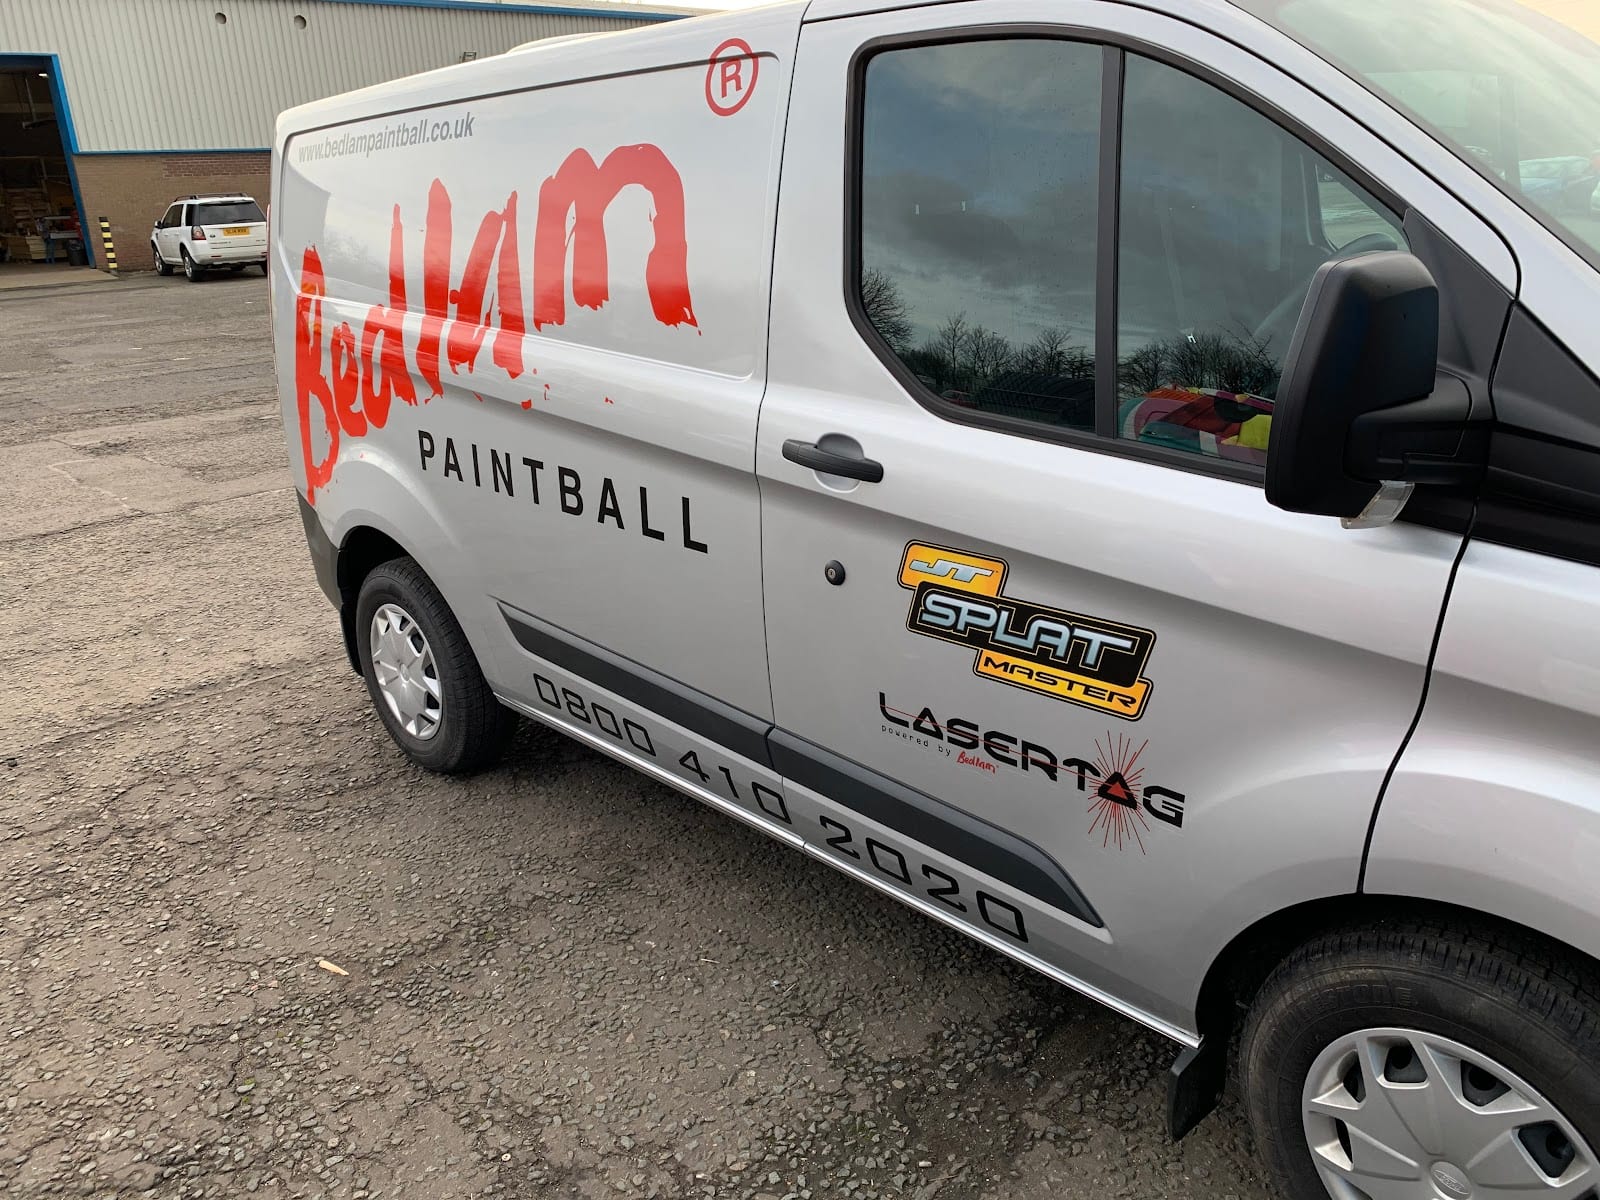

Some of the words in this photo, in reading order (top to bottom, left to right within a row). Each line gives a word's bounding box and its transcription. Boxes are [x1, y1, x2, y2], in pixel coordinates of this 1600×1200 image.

[299, 111, 475, 163] www.bedlampaintball.co.uk
[296, 144, 702, 505] Bedlam
[418, 429, 708, 554] PAINTBALL
[921, 593, 1133, 665] SPLAT
[983, 656, 1137, 708] MASTER
[879, 691, 1185, 829] LASERTAG
[881, 725, 929, 747] powered
[938, 745, 951, 757] by
[956, 750, 997, 774] Bedlam
[533, 673, 656, 757] 0800
[679, 750, 792, 824] 410
[820, 815, 1029, 943] 2020
